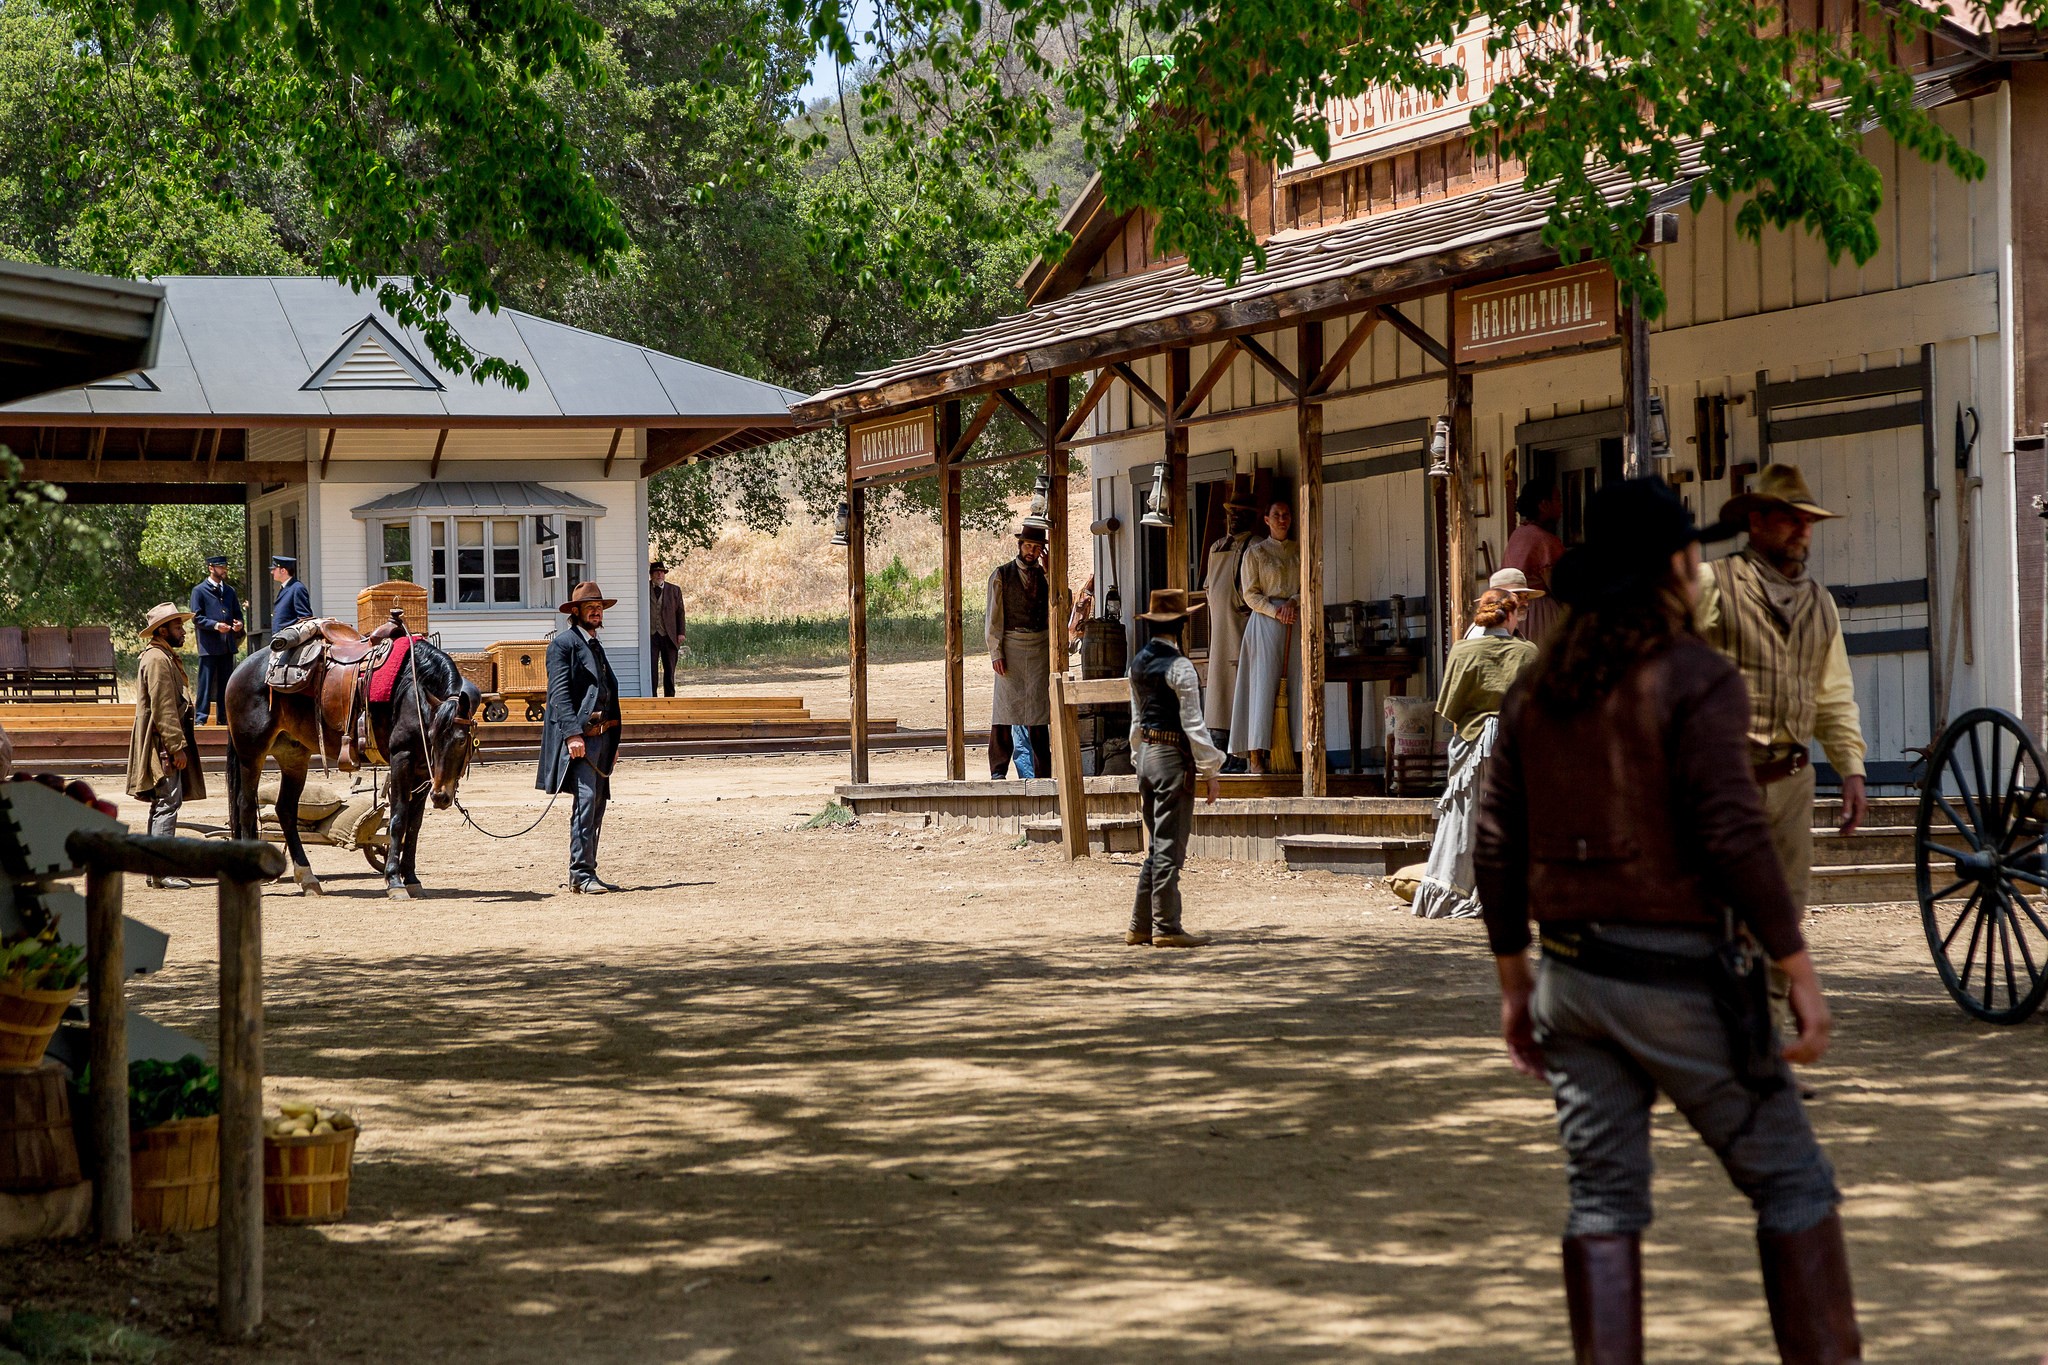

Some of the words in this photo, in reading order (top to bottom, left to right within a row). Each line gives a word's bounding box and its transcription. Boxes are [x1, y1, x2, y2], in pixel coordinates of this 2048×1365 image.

[1302, 51, 1444, 136] USEWA
[1456, 45, 1469, 102] &
[1472, 282, 1592, 340] AGRICULTURAL
[862, 422, 923, 462] CONSTRUCTION
